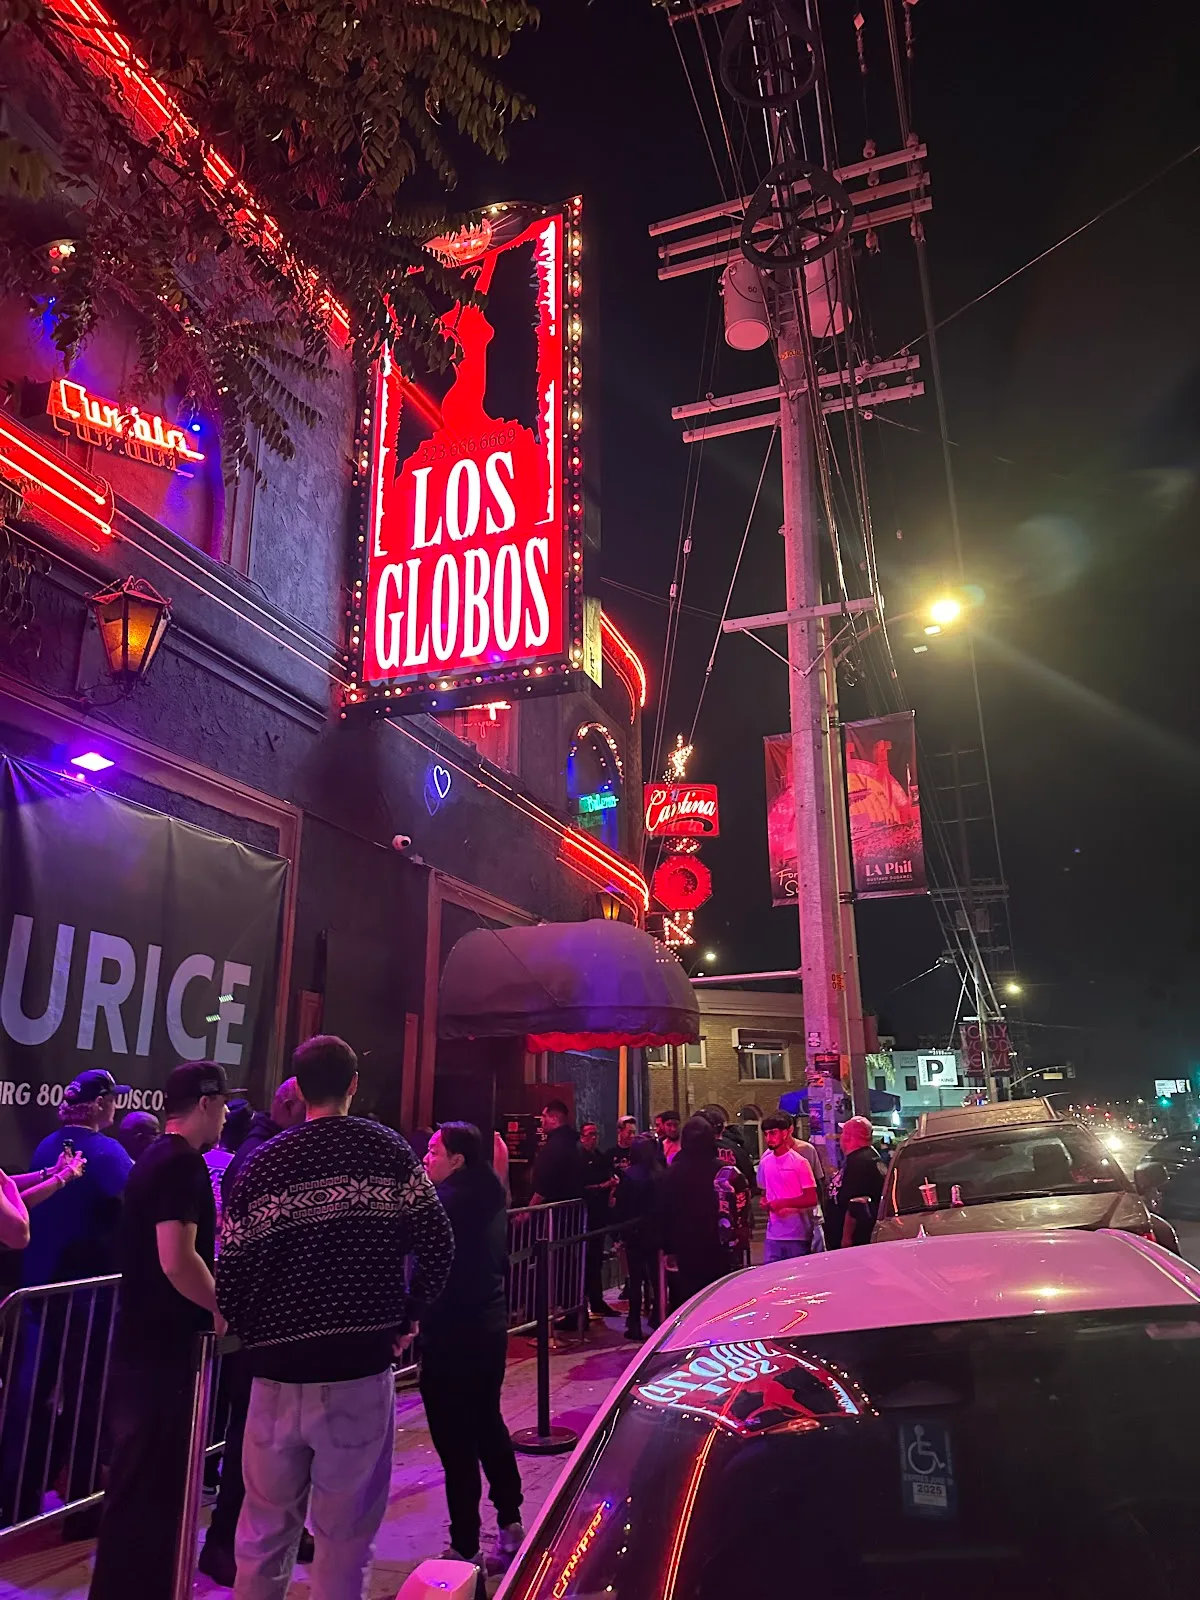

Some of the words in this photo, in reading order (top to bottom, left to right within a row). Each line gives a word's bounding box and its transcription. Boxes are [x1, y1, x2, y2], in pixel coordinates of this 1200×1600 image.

[420, 427, 516, 463] 323.666.6669
[411, 451, 516, 550] LOS
[375, 537, 550, 670] GLOBOS
[645, 789, 716, 832] Cantina
[865, 864, 882, 877] LA
[884, 859, 912, 875] Phil
[1, 914, 251, 1066] URICE
[926, 1060, 944, 1082] P
[114, 1088, 168, 1111] DISCO
[917, 1484, 943, 1495] 2025
